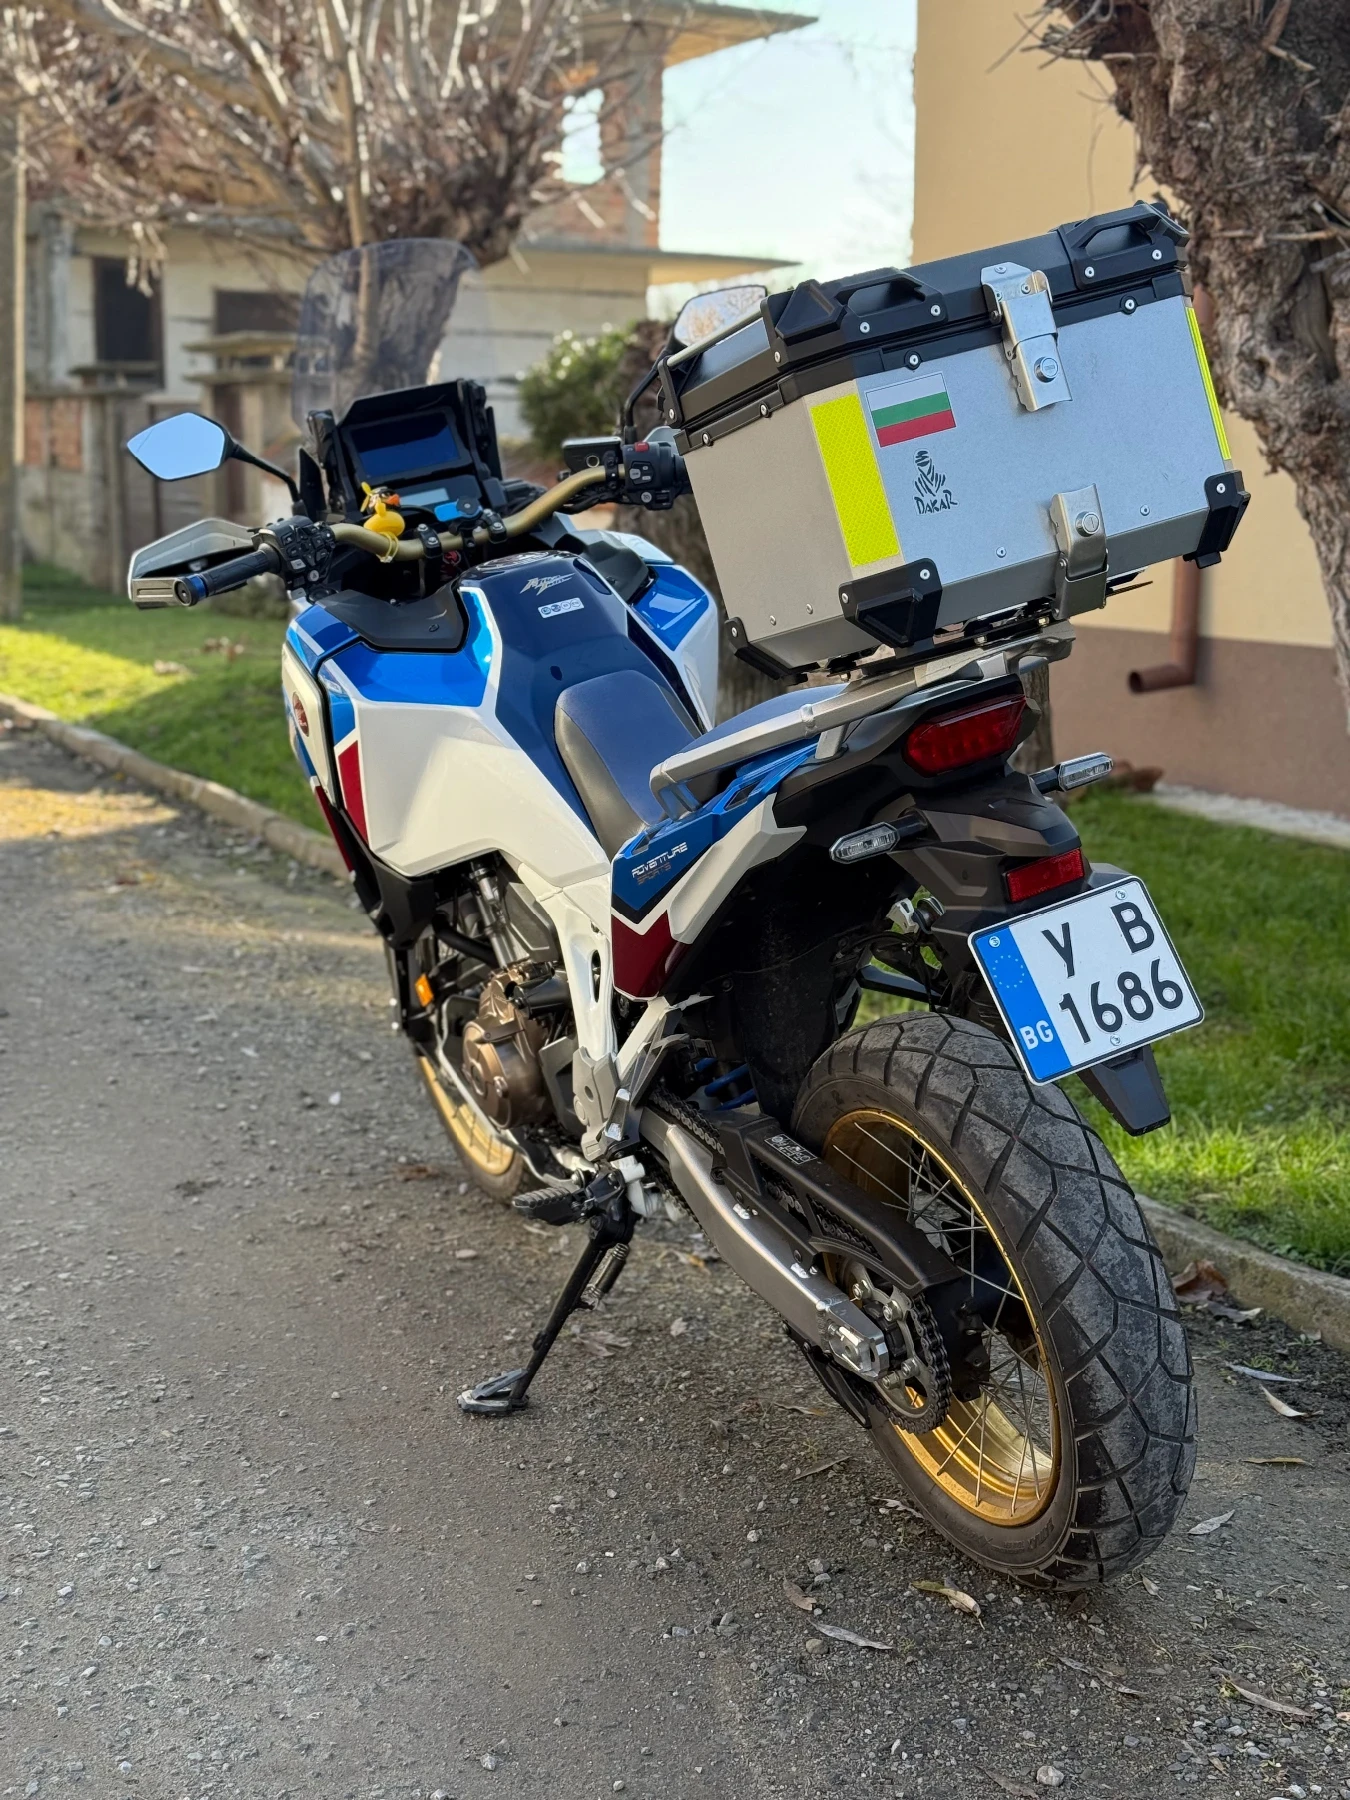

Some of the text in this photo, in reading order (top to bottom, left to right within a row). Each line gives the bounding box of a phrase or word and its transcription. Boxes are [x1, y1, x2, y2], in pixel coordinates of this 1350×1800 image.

[914, 489, 958, 514] DAKAR
[1041, 901, 1155, 978] Y B
[1058, 958, 1184, 1044] 1686
[1019, 1019, 1054, 1050] BG
